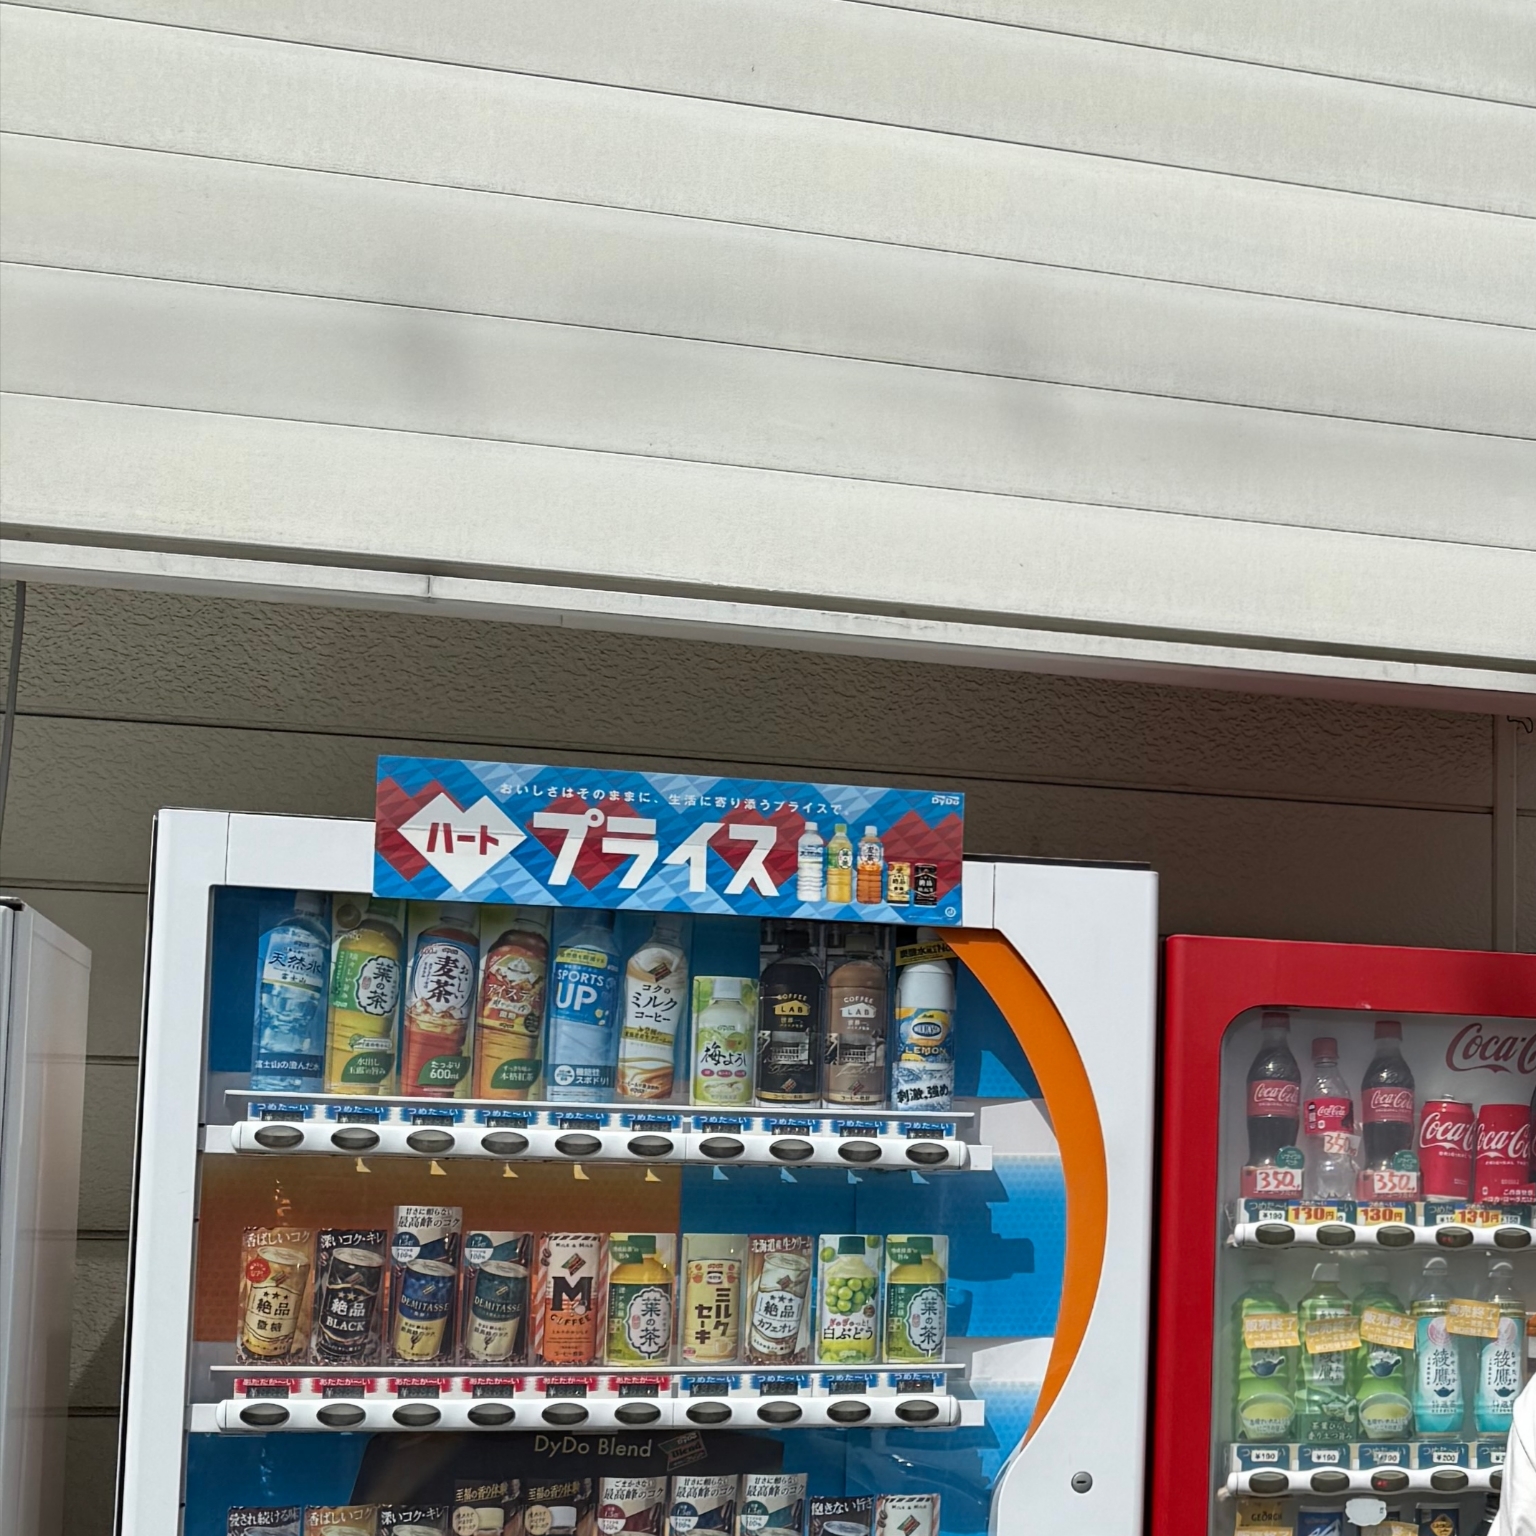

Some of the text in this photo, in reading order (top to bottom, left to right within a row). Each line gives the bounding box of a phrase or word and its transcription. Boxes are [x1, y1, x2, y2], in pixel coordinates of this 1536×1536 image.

[426, 822, 500, 858] ハート
[533, 807, 779, 897] プライス
[269, 951, 322, 975] 天然水
[366, 961, 395, 1010] 葉の茶
[427, 955, 459, 1004] 麦茶
[456, 965, 470, 1000] おいしい
[557, 968, 605, 988] SPORTS
[555, 981, 598, 1011] UP
[642, 983, 671, 995] コクの
[631, 992, 678, 1012] ミルク
[843, 995, 874, 1004] COFFEE
[635, 1011, 671, 1023] コーヒー
[847, 1008, 870, 1016] LAB
[905, 1046, 947, 1056] LEMON
[398, 1216, 461, 1229] 最高峰のコク
[247, 1231, 311, 1248] 香ばしいコク
[551, 1276, 593, 1312] M
[256, 1299, 291, 1316] 絶品
[330, 1298, 366, 1317] 絶品
[400, 1294, 450, 1312] DEMITASSE
[474, 1296, 522, 1313] DEMITASSE
[764, 1302, 795, 1319] 絶品
[713, 1288, 732, 1337] ミルク
[1450, 1304, 1496, 1320] 販売終了
[326, 1315, 366, 1332] BLACK
[640, 1296, 662, 1348] 葉の茶
[695, 1304, 713, 1345] セーキ
[757, 1318, 796, 1334] カフェオレ
[919, 1297, 938, 1346] 葉の茶
[1245, 1318, 1296, 1332] 販売終了
[1308, 1320, 1358, 1335] 販売終了
[1363, 1313, 1415, 1331] 販売終了
[823, 1326, 874, 1341] 白ぶどう
[1432, 1348, 1451, 1387] 綾鷹
[1493, 1349, 1513, 1387] 綾鷹
[534, 1434, 652, 1458] DyDo Blend
[1254, 1452, 1276, 1460] ¥190
[1315, 1453, 1337, 1462] ¥190
[604, 1488, 664, 1501] 最高峰のコク
[675, 1485, 736, 1498] 最高峰のコク
[746, 1484, 805, 1498] 最高峰のコク
[308, 1508, 373, 1526] 香ばしいコク
